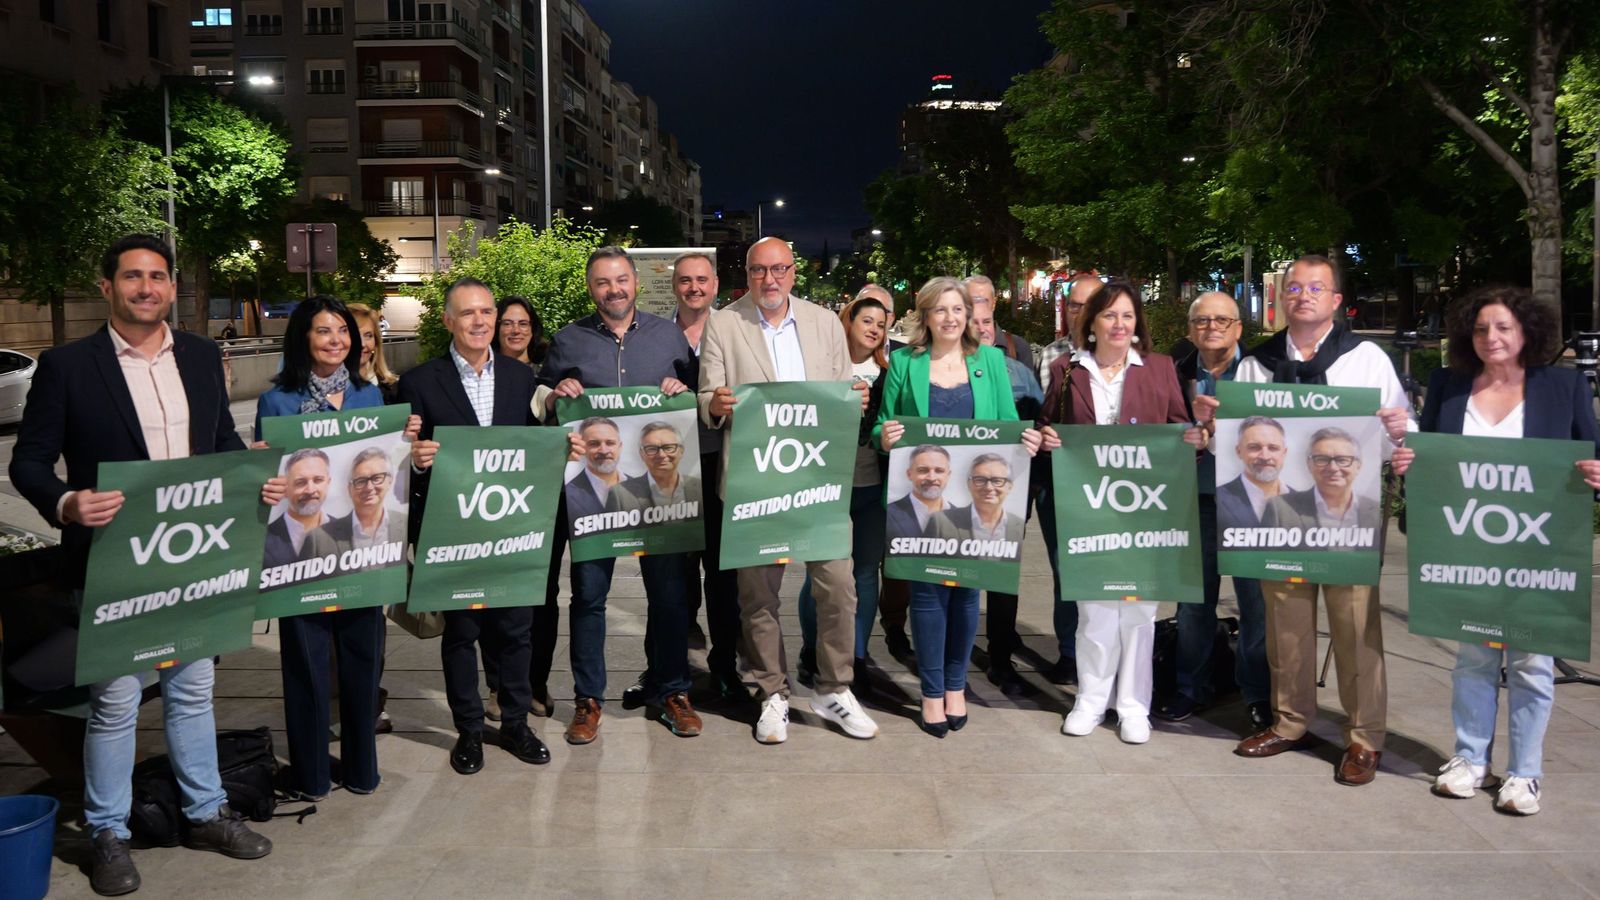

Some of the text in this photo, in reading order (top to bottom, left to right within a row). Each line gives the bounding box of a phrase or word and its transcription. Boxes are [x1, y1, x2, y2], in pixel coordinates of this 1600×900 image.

[589, 393, 662, 409] VOTA VOX
[1254, 390, 1339, 410] VOTA VOX
[303, 416, 379, 438] VOTA VOX
[765, 404, 817, 427] VOTA
[926, 424, 999, 439] VOTA VOX
[474, 449, 525, 473] VOTA
[753, 436, 828, 473] VOX
[1094, 445, 1151, 469] VOTA
[1459, 462, 1533, 492] VOTA
[157, 478, 222, 512] VOTA
[458, 482, 533, 521] VOX
[732, 484, 841, 520] SENTIDO COMÚN
[1083, 476, 1167, 512] VOX
[575, 500, 698, 535] SENTIDO COMÚN
[1443, 498, 1551, 544] VOX
[129, 517, 235, 566] VOX
[426, 531, 544, 563] SENTIDO COMÚN
[890, 538, 1018, 558] SENTIDO COMÚN
[1069, 529, 1188, 554] SENTIDO COMÚN
[1223, 525, 1374, 547] SENTIDO COMÚN
[260, 541, 402, 588] SENTIDO COMÚN
[1421, 564, 1576, 591] SENTIDO COMÚN
[94, 568, 249, 624] SENTIDO COMÚN
